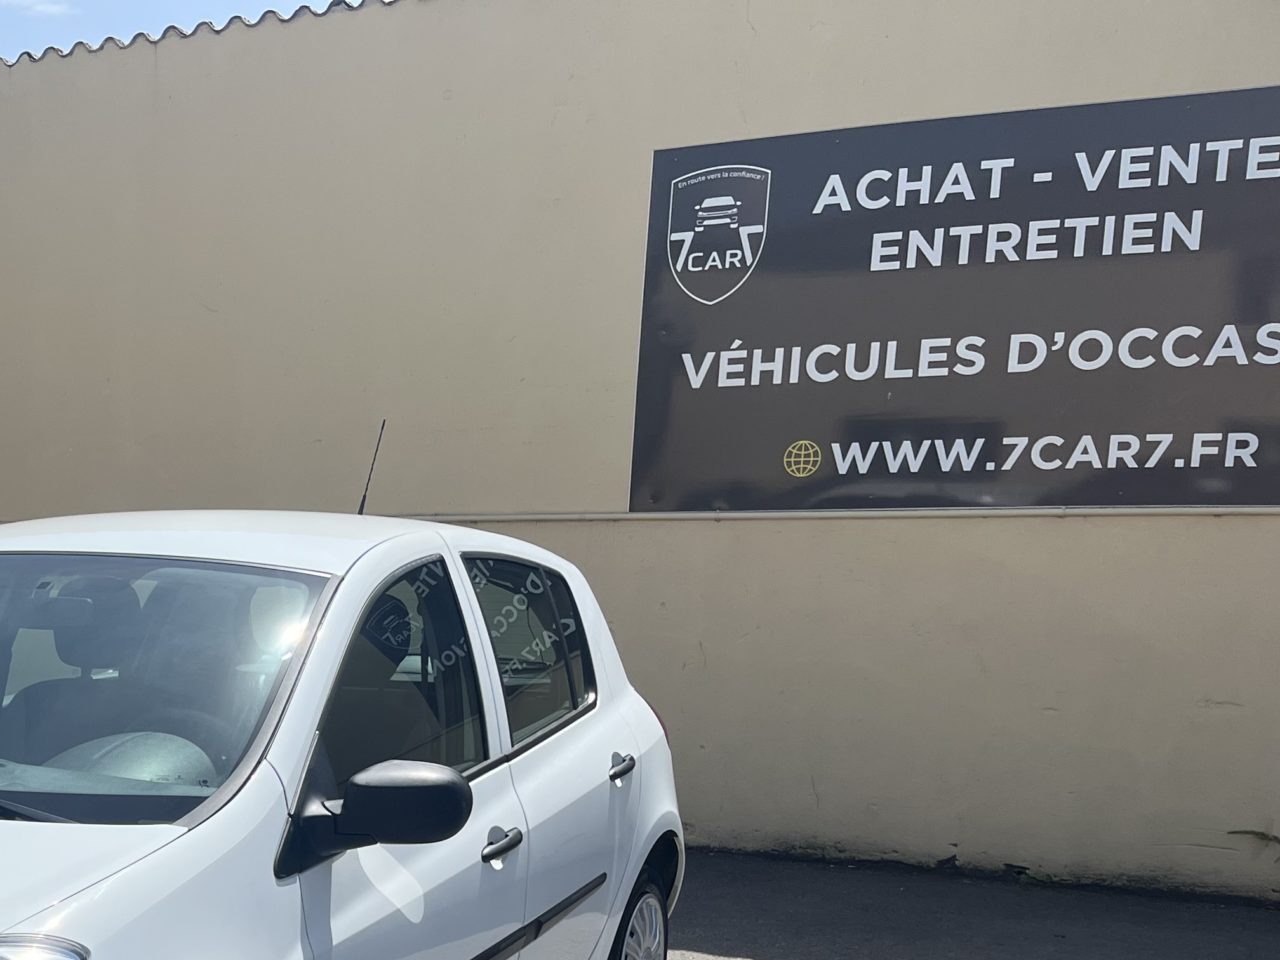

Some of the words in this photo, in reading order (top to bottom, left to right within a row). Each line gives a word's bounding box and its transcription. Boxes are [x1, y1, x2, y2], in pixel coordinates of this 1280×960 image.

[687, 175, 706, 185] route
[707, 172, 721, 180] vers
[729, 170, 761, 180] confiance
[812, 157, 1015, 214] ACHAT
[1075, 136, 1280, 191] VENTE
[870, 209, 1204, 271] ENTRETIEN
[682, 335, 986, 389] VÉHICULES
[831, 432, 1260, 476] WWW.7CAR7.FR
